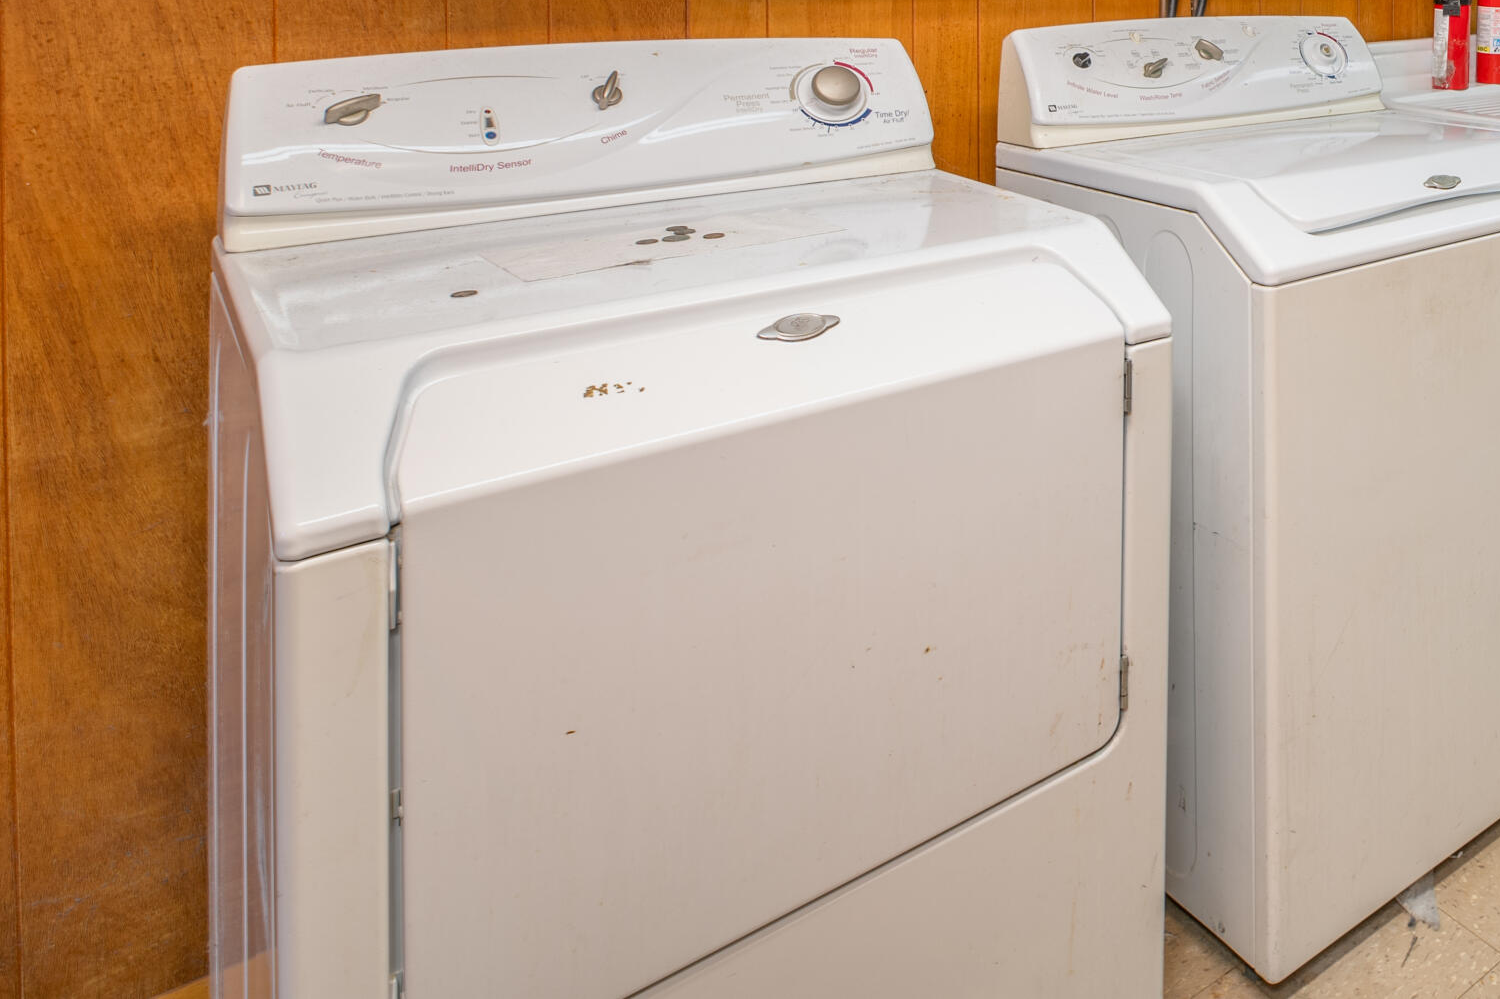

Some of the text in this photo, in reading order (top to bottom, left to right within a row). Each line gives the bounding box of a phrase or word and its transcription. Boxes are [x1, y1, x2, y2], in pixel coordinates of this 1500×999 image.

[723, 93, 769, 102] Permanent
[600, 129, 628, 144] Chime
[318, 148, 382, 169] Temperature
[450, 158, 532, 173] IntelliDry Sensor
